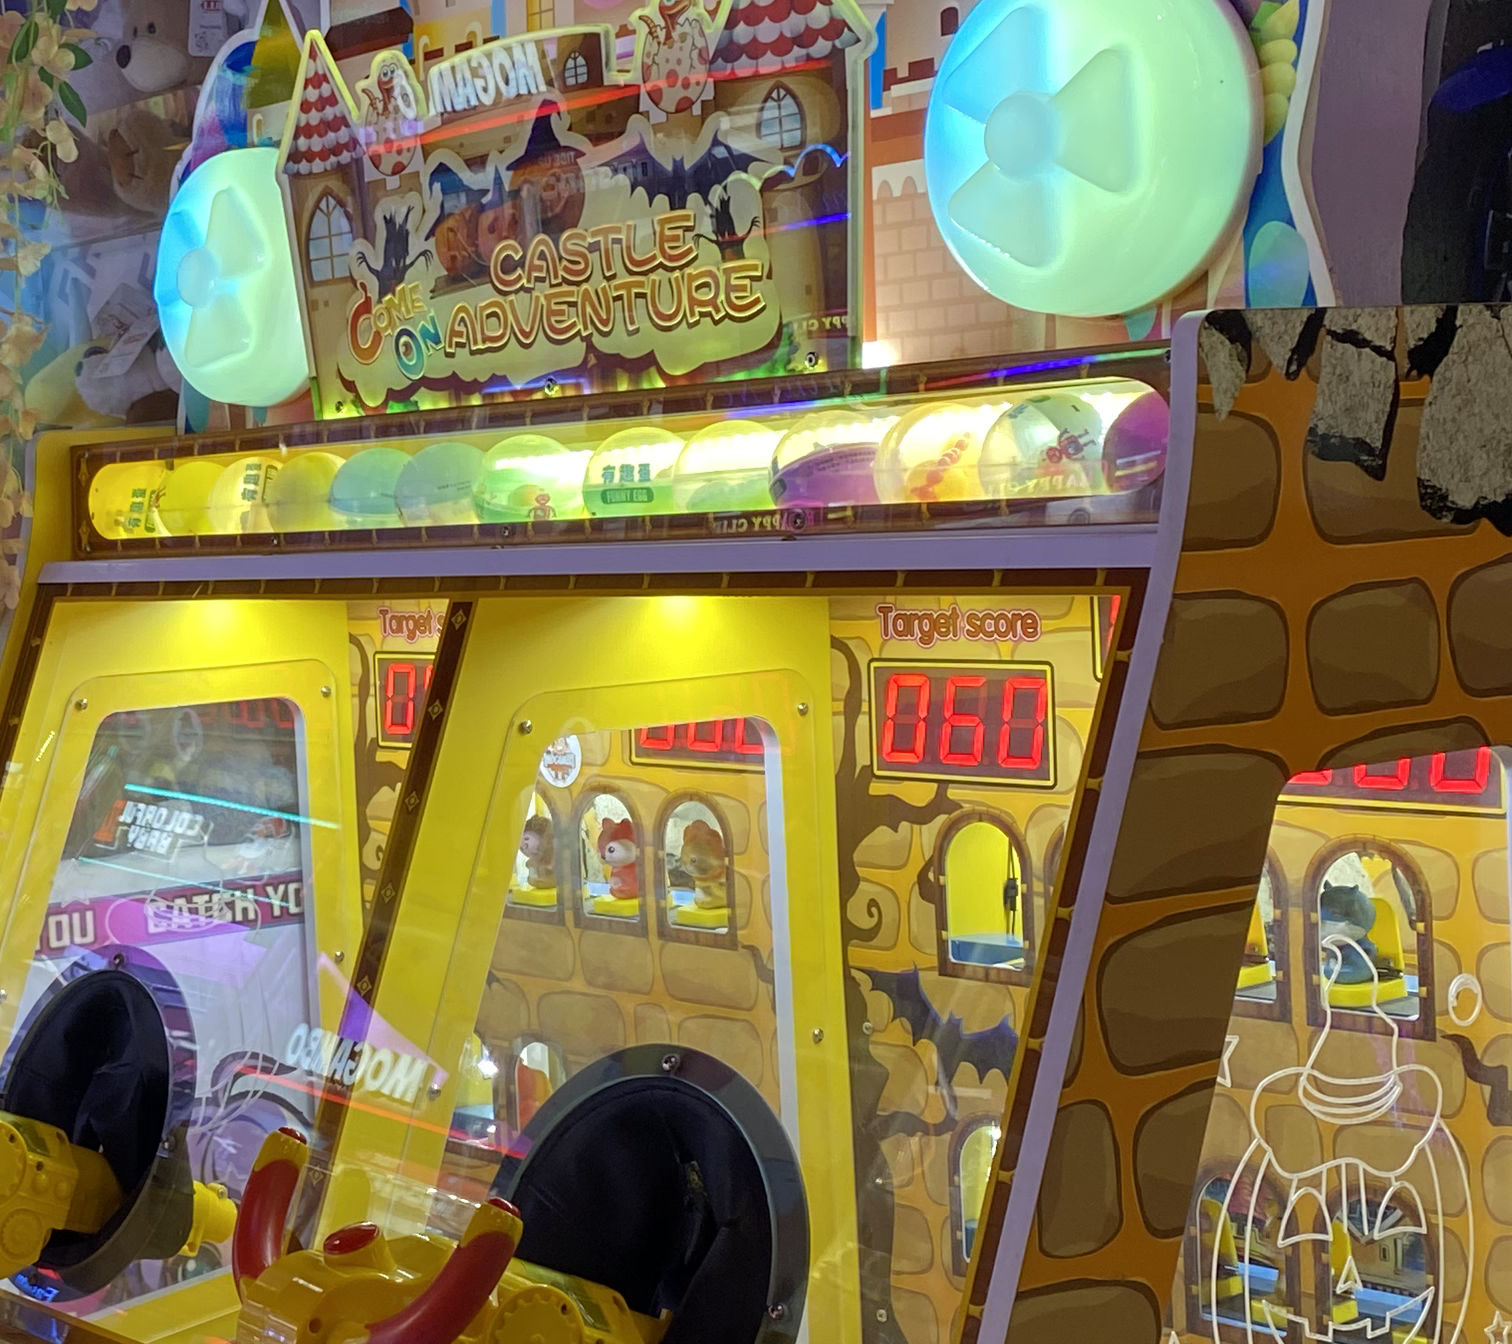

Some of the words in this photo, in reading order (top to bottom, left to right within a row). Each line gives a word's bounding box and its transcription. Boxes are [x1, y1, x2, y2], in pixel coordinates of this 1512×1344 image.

[490, 209, 698, 297] CASTLE
[347, 280, 427, 366] COME
[394, 312, 442, 381] ON
[444, 259, 766, 359] ADVENTURE
[876, 604, 961, 647] Target
[963, 608, 1042, 642] score
[881, 672, 1049, 771] 060
